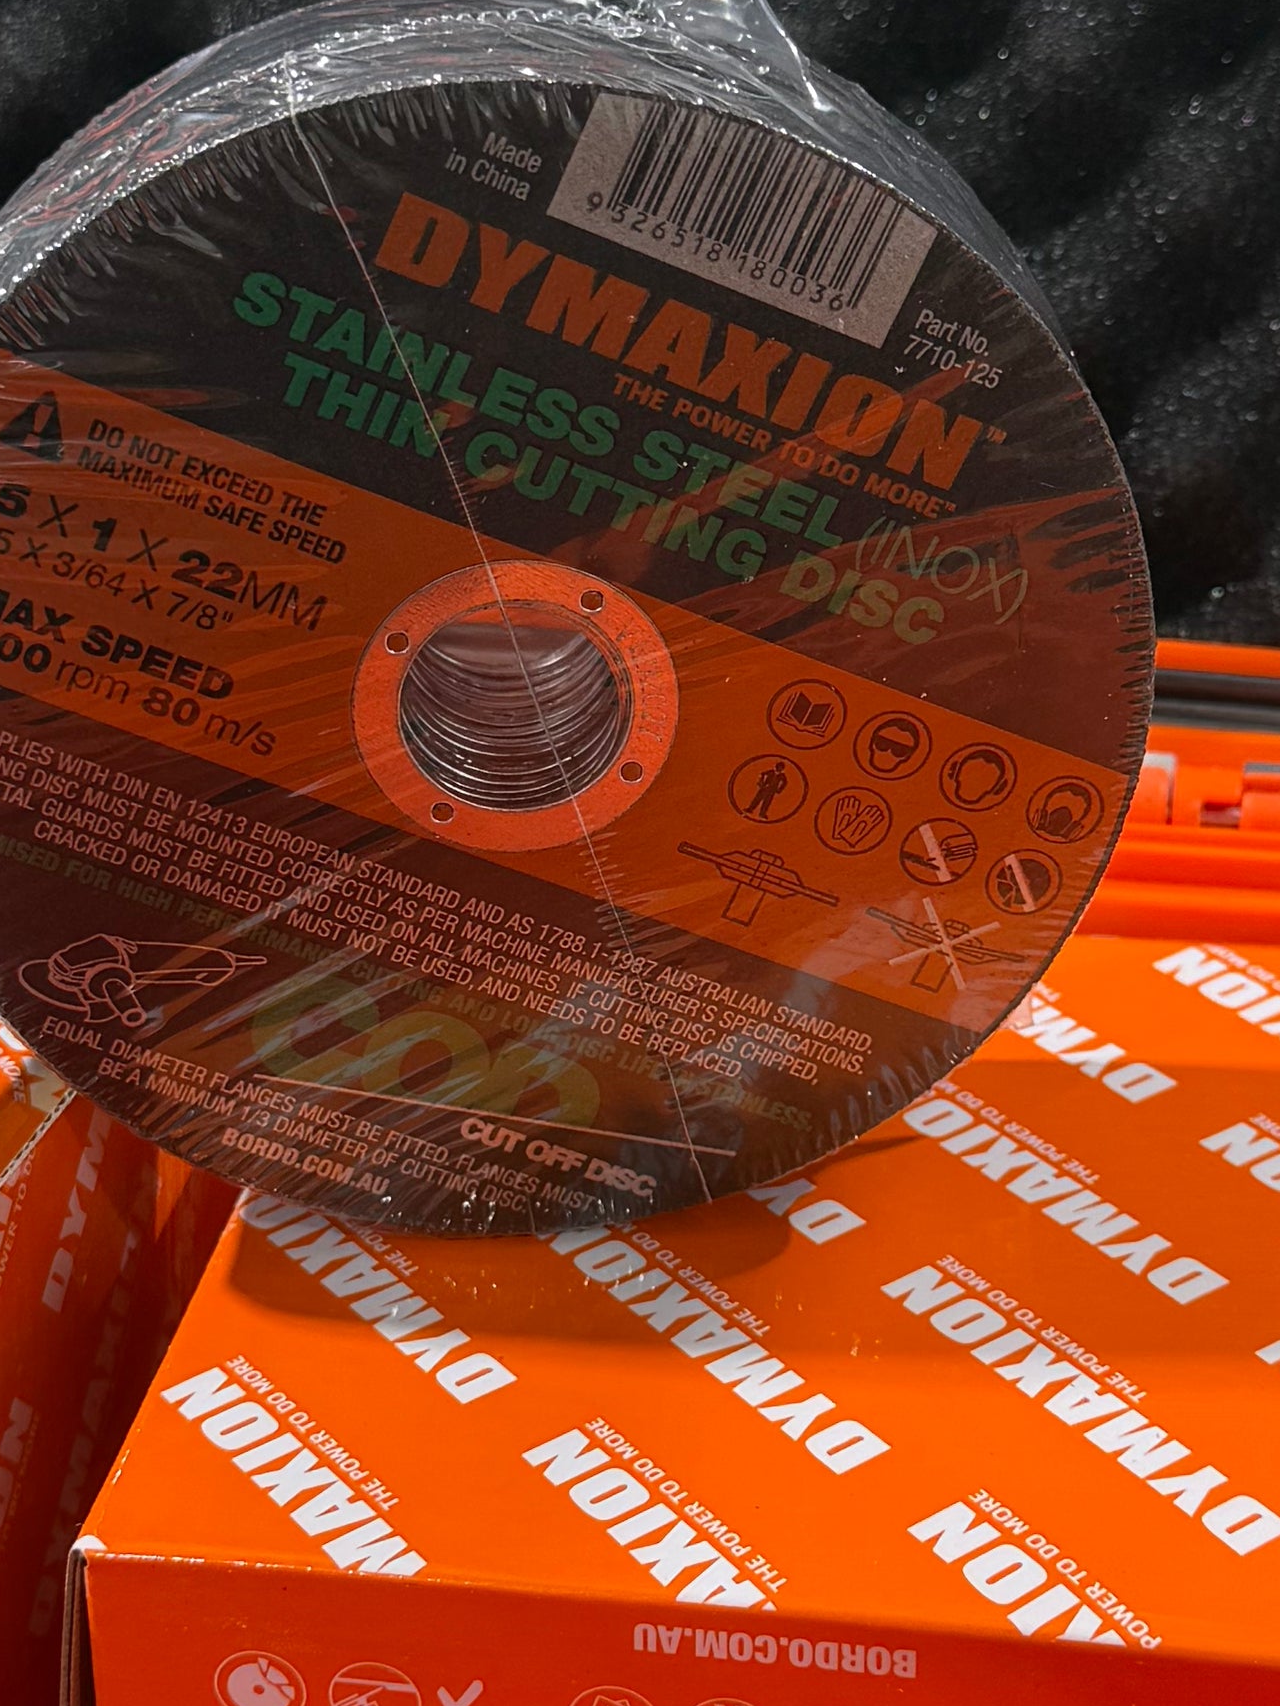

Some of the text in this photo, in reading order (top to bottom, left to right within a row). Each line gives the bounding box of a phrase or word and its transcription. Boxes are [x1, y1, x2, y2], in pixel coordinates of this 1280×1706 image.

[444, 147, 534, 201] in China
[479, 131, 545, 175] Made
[900, 334, 1004, 391] 7710-125
[913, 307, 994, 358] Part No.
[85, 417, 327, 528] DO NOT EXCEED THE
[227, 266, 1035, 631] STAINLESS STEEL (INOX)
[608, 372, 669, 413] THE
[669, 397, 773, 454] POWER
[772, 437, 817, 470] TO
[815, 454, 861, 488] DO
[75, 445, 348, 567] MAXIMUM SAFE SPEED
[270, 351, 948, 651] THIN CUTTING DISC
[50, 549, 127, 599] 3/64
[84, 514, 118, 553] 1
[169, 544, 328, 633] 22MM
[53, 655, 132, 711] rpm
[140, 684, 203, 730] 80
[202, 706, 280, 759] m/s
[77, 621, 237, 705] SPEED
[28, 766, 81, 801] DISC
[81, 785, 143, 823] MUST
[142, 806, 175, 834] BE
[173, 818, 273, 870] MOUNTED
[275, 852, 390, 912] CORRECTLY
[389, 893, 418, 920] AS
[418, 904, 462, 935] PER
[459, 919, 551, 966] MACHINE
[718, 1010, 868, 1076] SPECIFICATIONS.
[32, 816, 129, 868] CRACKED
[131, 853, 162, 879] OR
[163, 863, 263, 915] DAMAGED
[263, 899, 286, 922] IT
[286, 906, 347, 944] MUST
[345, 927, 390, 959] NOT
[389, 942, 419, 968] BE
[418, 953, 479, 992] USED,
[475, 971, 522, 1005] AND
[520, 988, 589, 1026] NEEDS
[590, 1011, 618, 1036] TO
[617, 1021, 645, 1046] BE
[40, 794, 125, 841] GUARDS
[126, 825, 187, 863] MUST
[186, 847, 217, 874] BE
[216, 857, 288, 899] FITTED
[287, 882, 332, 915] AND
[332, 898, 388, 934] USED
[388, 918, 420, 945] ON
[419, 929, 459, 958] ALL
[459, 943, 564, 995] MACHINES.
[566, 980, 589, 1004] IF
[586, 987, 669, 1031] CUTTING
[669, 1017, 715, 1046] DISC
[715, 1032, 736, 1053] IS
[737, 1039, 823, 1085] CHIPPED,
[54, 751, 110, 787] WITH
[110, 771, 149, 801] DIN
[149, 785, 182, 812] EN
[182, 796, 249, 836] 12413
[248, 819, 356, 875] EUROPEAN
[355, 857, 459, 911] STANDARD
[460, 895, 504, 926] AND
[505, 910, 535, 936] AS
[655, 965, 772, 1019] AUSTRALIAN
[771, 1005, 877, 1056] STANDARD.
[41, 1014, 598, 1213] EQUAL DIAMETER FLANGES MUST BE FITTED. FLANGES MUST
[96, 1057, 126, 1082] BE
[125, 1066, 145, 1088] A
[144, 1070, 237, 1120] MINIMUM
[236, 1103, 271, 1132] 1/3
[272, 1112, 368, 1165] DIAMETER
[369, 1146, 398, 1172] OF
[398, 1154, 480, 1200] CUTTING
[221, 1123, 389, 1203] BORDO.COM.AU
[457, 1116, 659, 1199] CUT OFF DISC
[936, 1254, 1147, 1403] THE POWER TO DO MORE
[632, 1622, 916, 1678] BORDO.COM.AU
